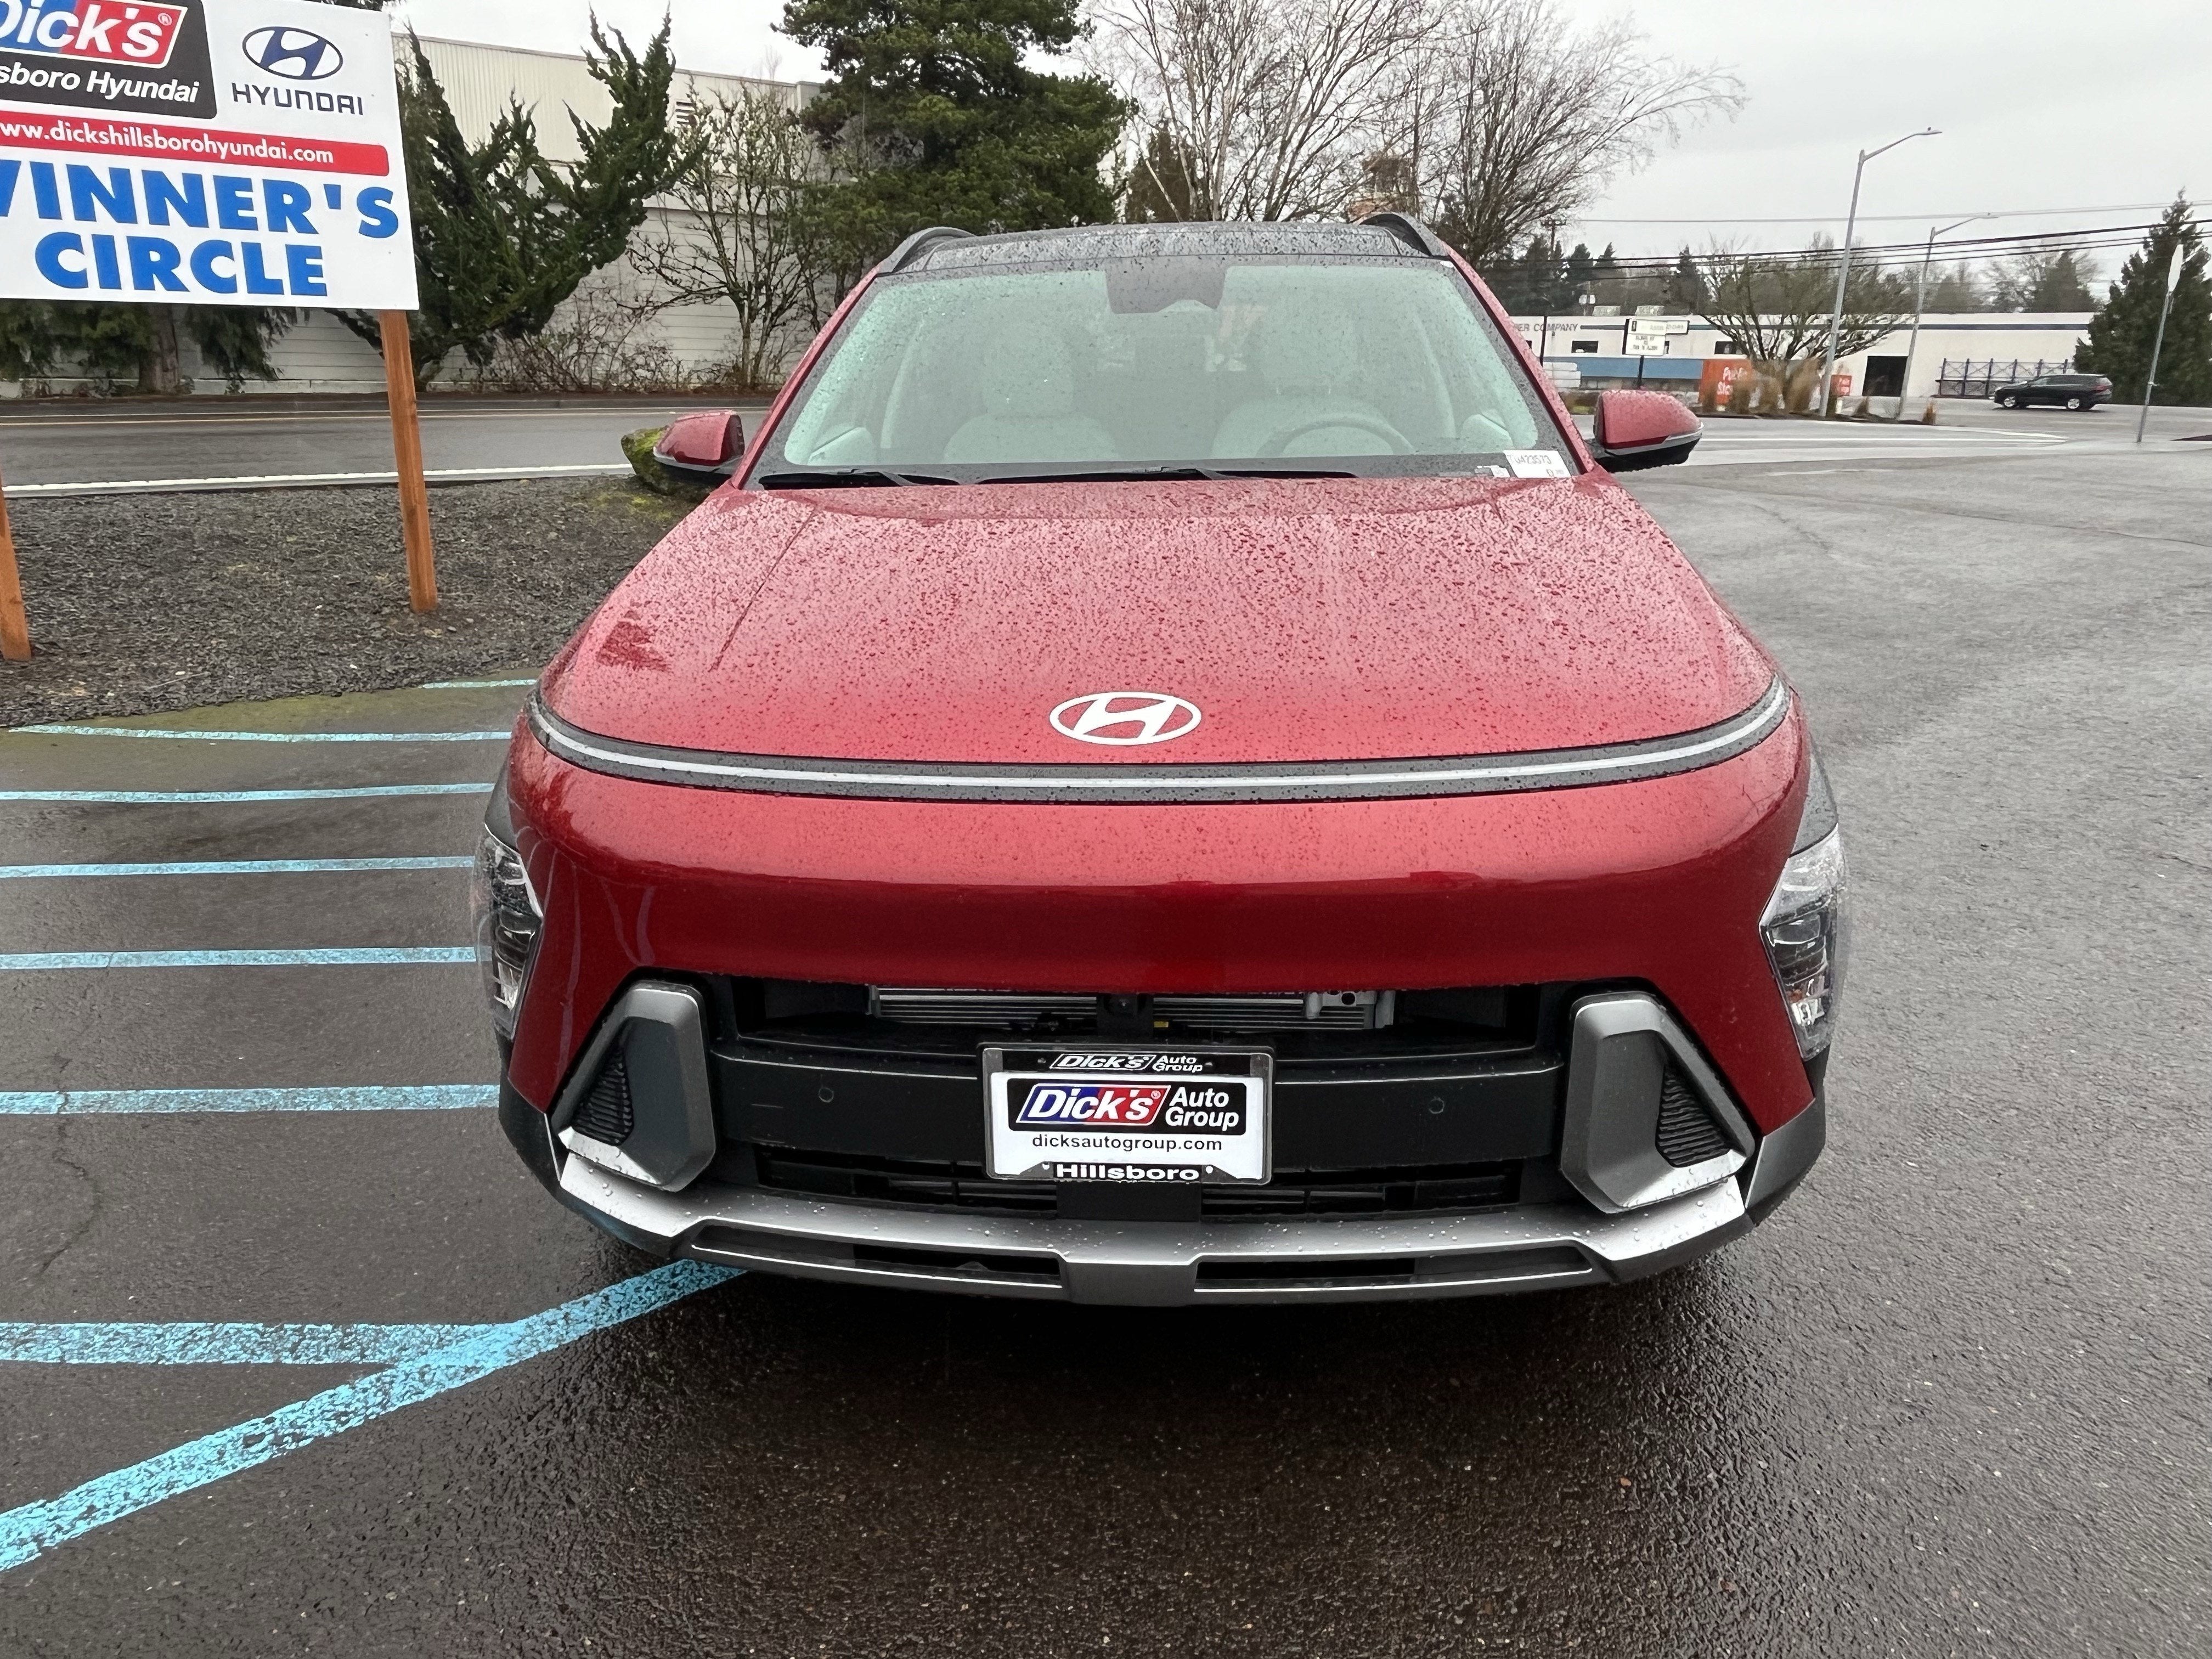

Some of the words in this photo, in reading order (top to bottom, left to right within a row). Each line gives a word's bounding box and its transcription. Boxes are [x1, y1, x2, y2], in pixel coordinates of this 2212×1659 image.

[86, 70, 200, 103] Hyundai
[231, 82, 364, 116] HYUNDAI
[35, 231, 328, 296] CIRCLE
[1057, 1055, 1144, 1069] Dick's
[1158, 1055, 1197, 1064] Auto
[1152, 1062, 1203, 1073] Group
[1028, 1087, 1154, 1120] Dick's
[1169, 1086, 1229, 1108] Auto
[1165, 1107, 1239, 1131] Group
[1032, 1134, 1222, 1152] dicksautogroup.com
[1056, 1164, 1200, 1181] Hillsboro
